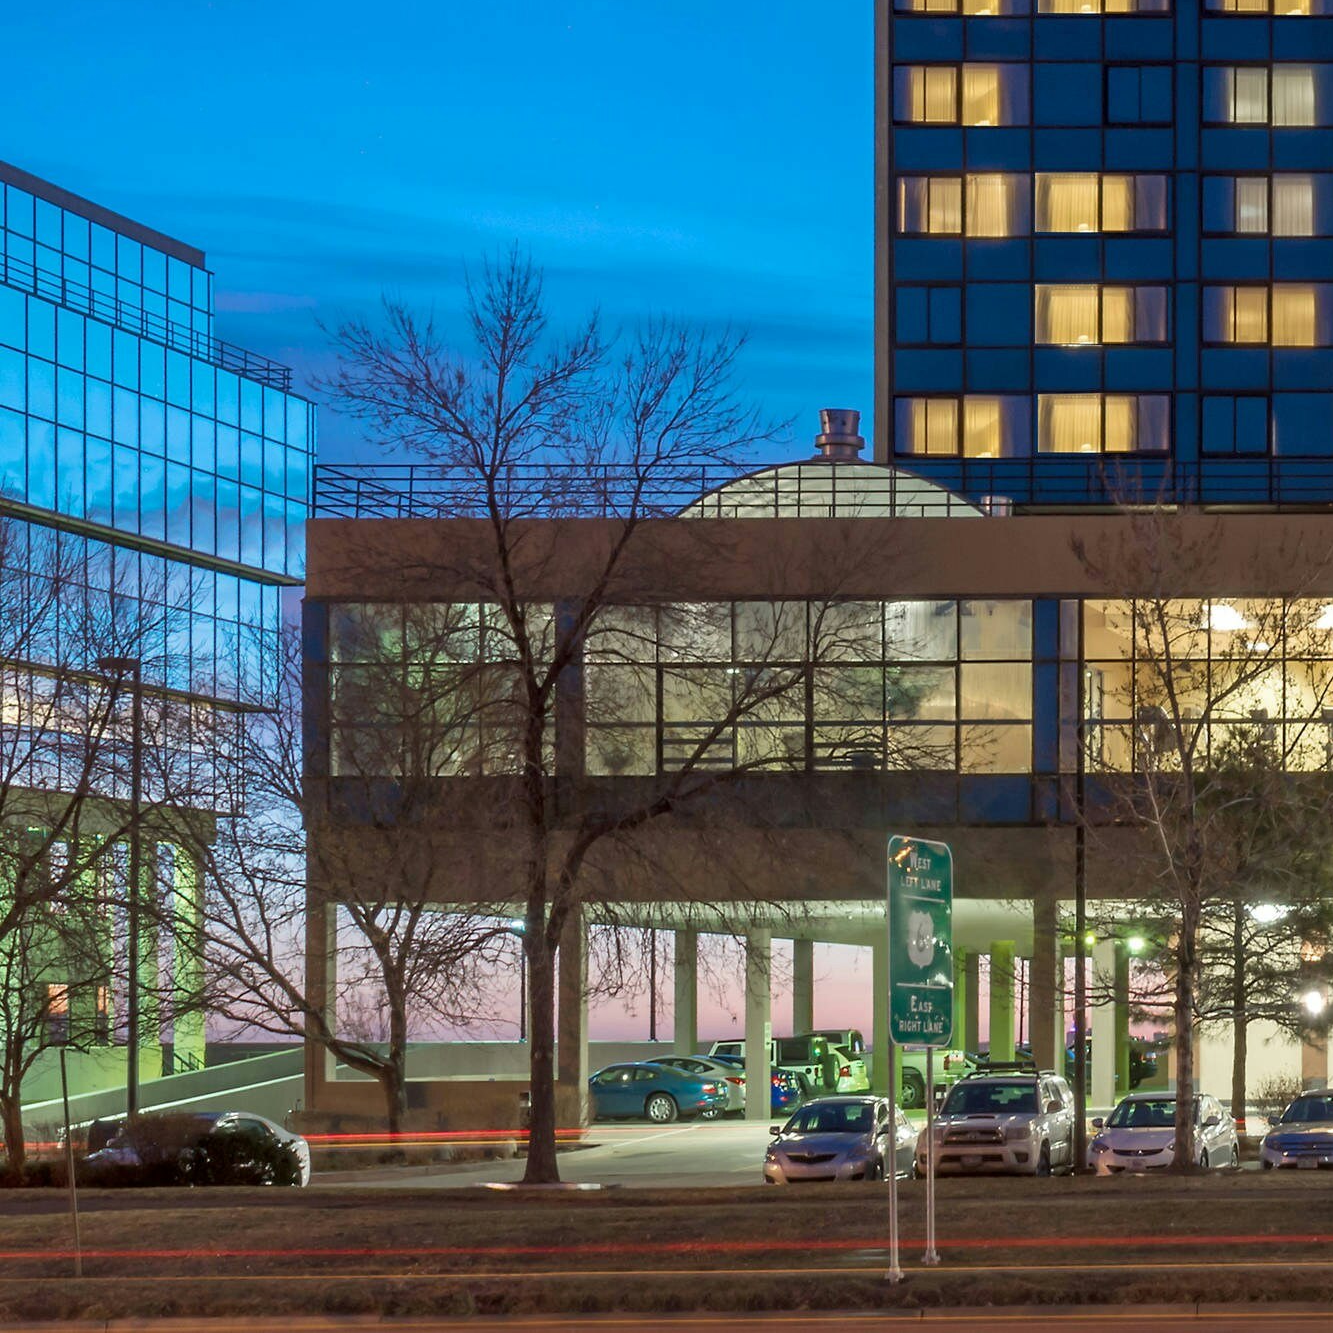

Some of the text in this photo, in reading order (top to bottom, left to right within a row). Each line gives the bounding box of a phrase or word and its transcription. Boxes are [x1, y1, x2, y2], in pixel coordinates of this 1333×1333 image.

[909, 851, 932, 871] WEST
[900, 875, 942, 892] LEFT LANE
[916, 922, 926, 953] 6
[898, 1019, 944, 1034] RIGHT LANE
